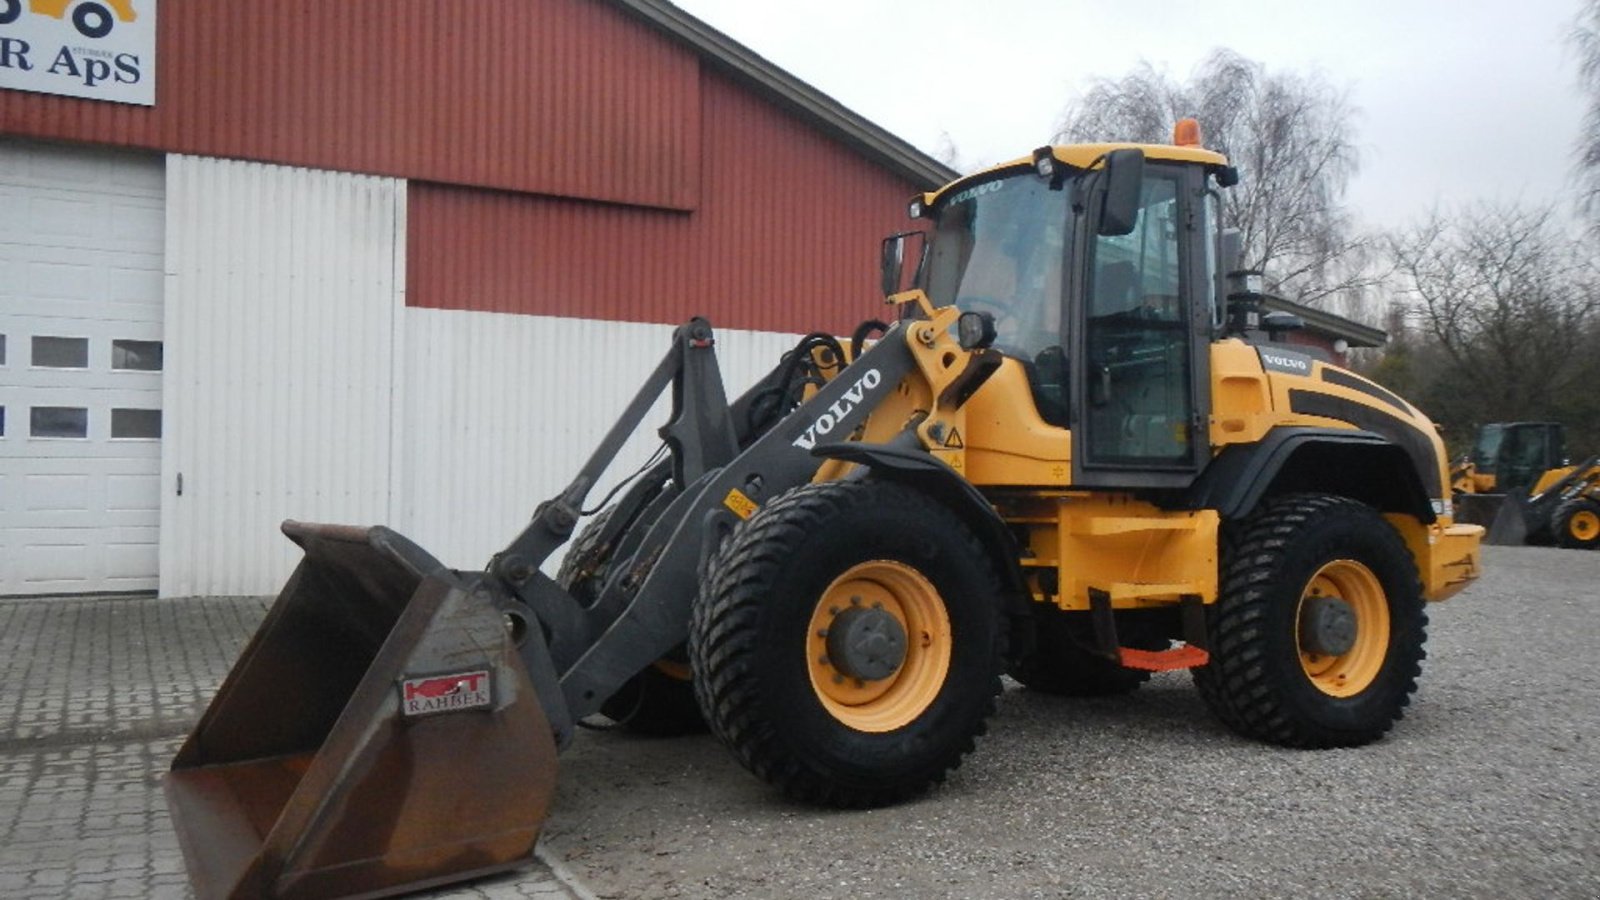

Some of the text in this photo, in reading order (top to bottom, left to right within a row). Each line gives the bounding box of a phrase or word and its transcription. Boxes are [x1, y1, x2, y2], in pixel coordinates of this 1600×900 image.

[47, 45, 141, 87] ApS
[950, 180, 1003, 207] VOLVO
[1263, 354, 1307, 370] VOLVO
[792, 368, 881, 450] VOLVO
[408, 692, 486, 712] RAHBEK
